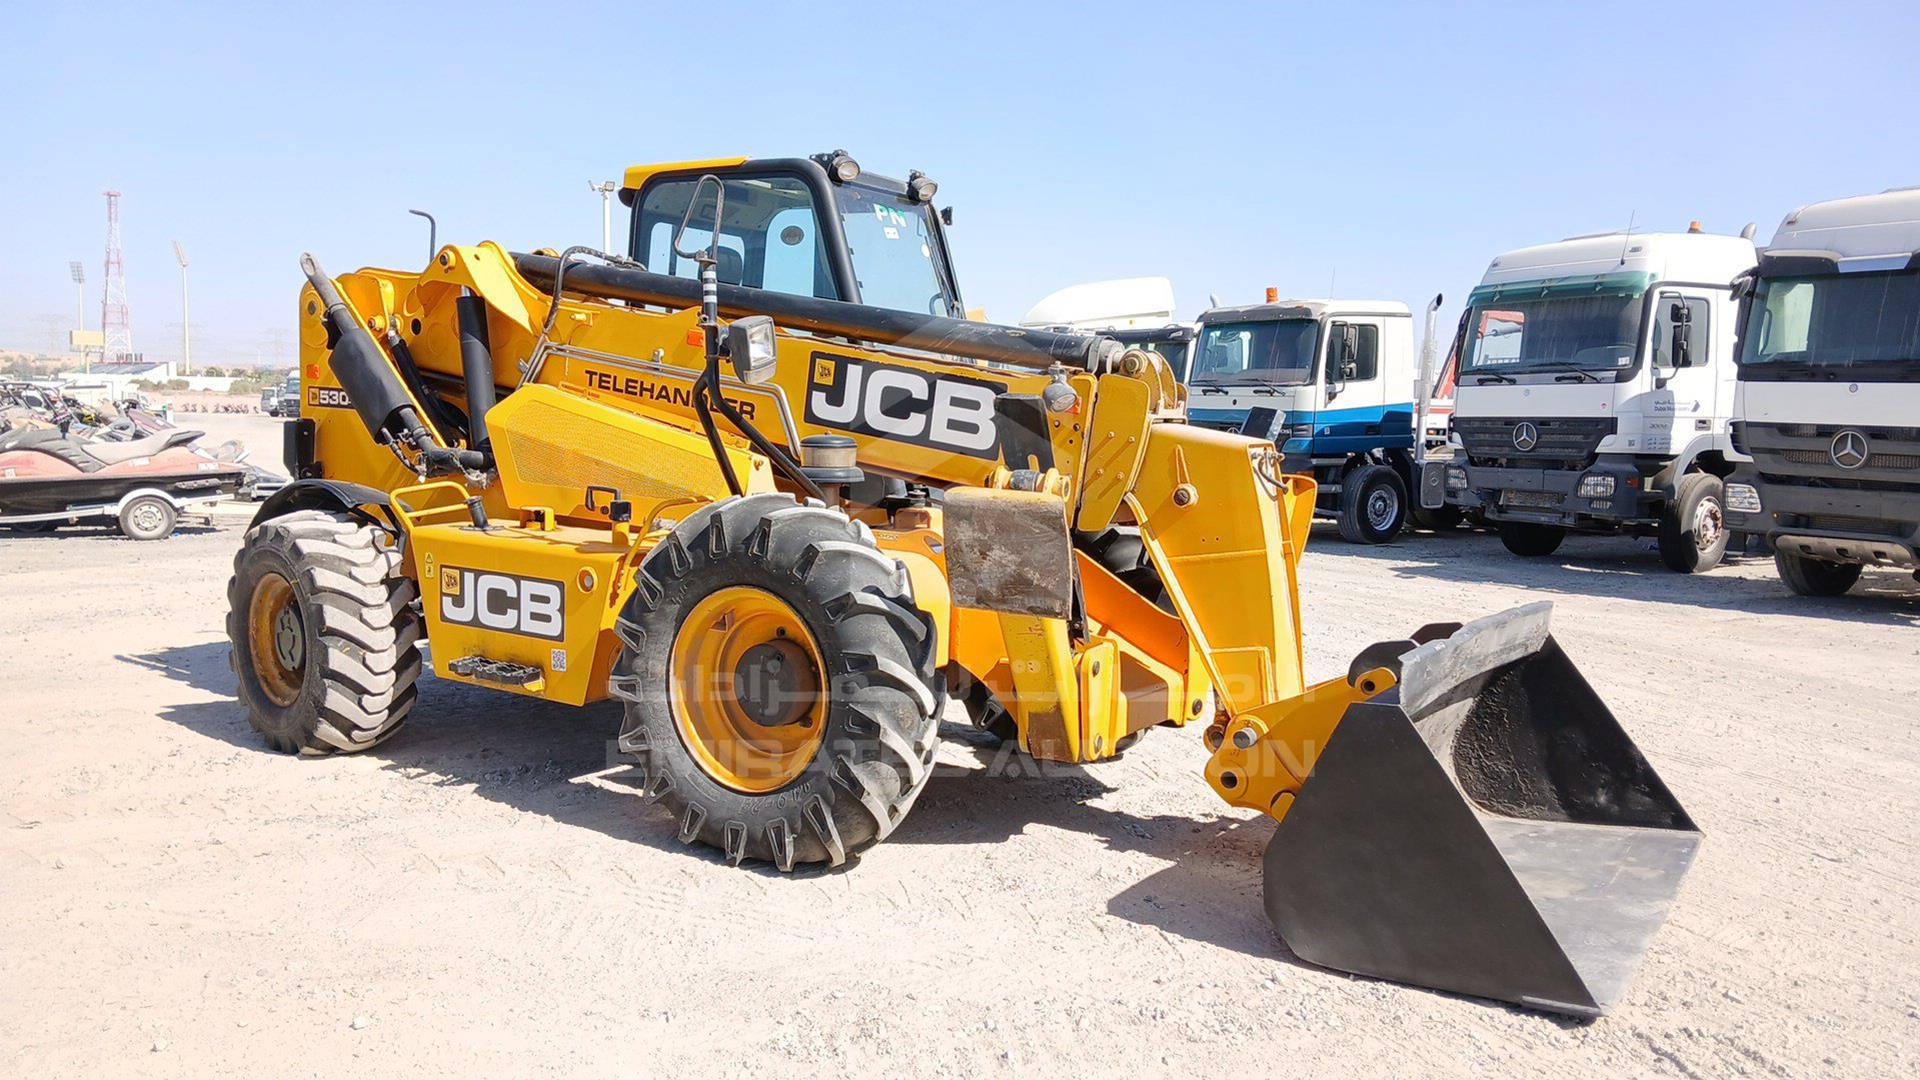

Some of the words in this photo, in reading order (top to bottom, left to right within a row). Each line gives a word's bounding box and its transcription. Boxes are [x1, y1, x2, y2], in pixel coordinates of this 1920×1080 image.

[320, 390, 351, 405] 530
[811, 363, 997, 450] JCB
[442, 571, 562, 637] JCB
